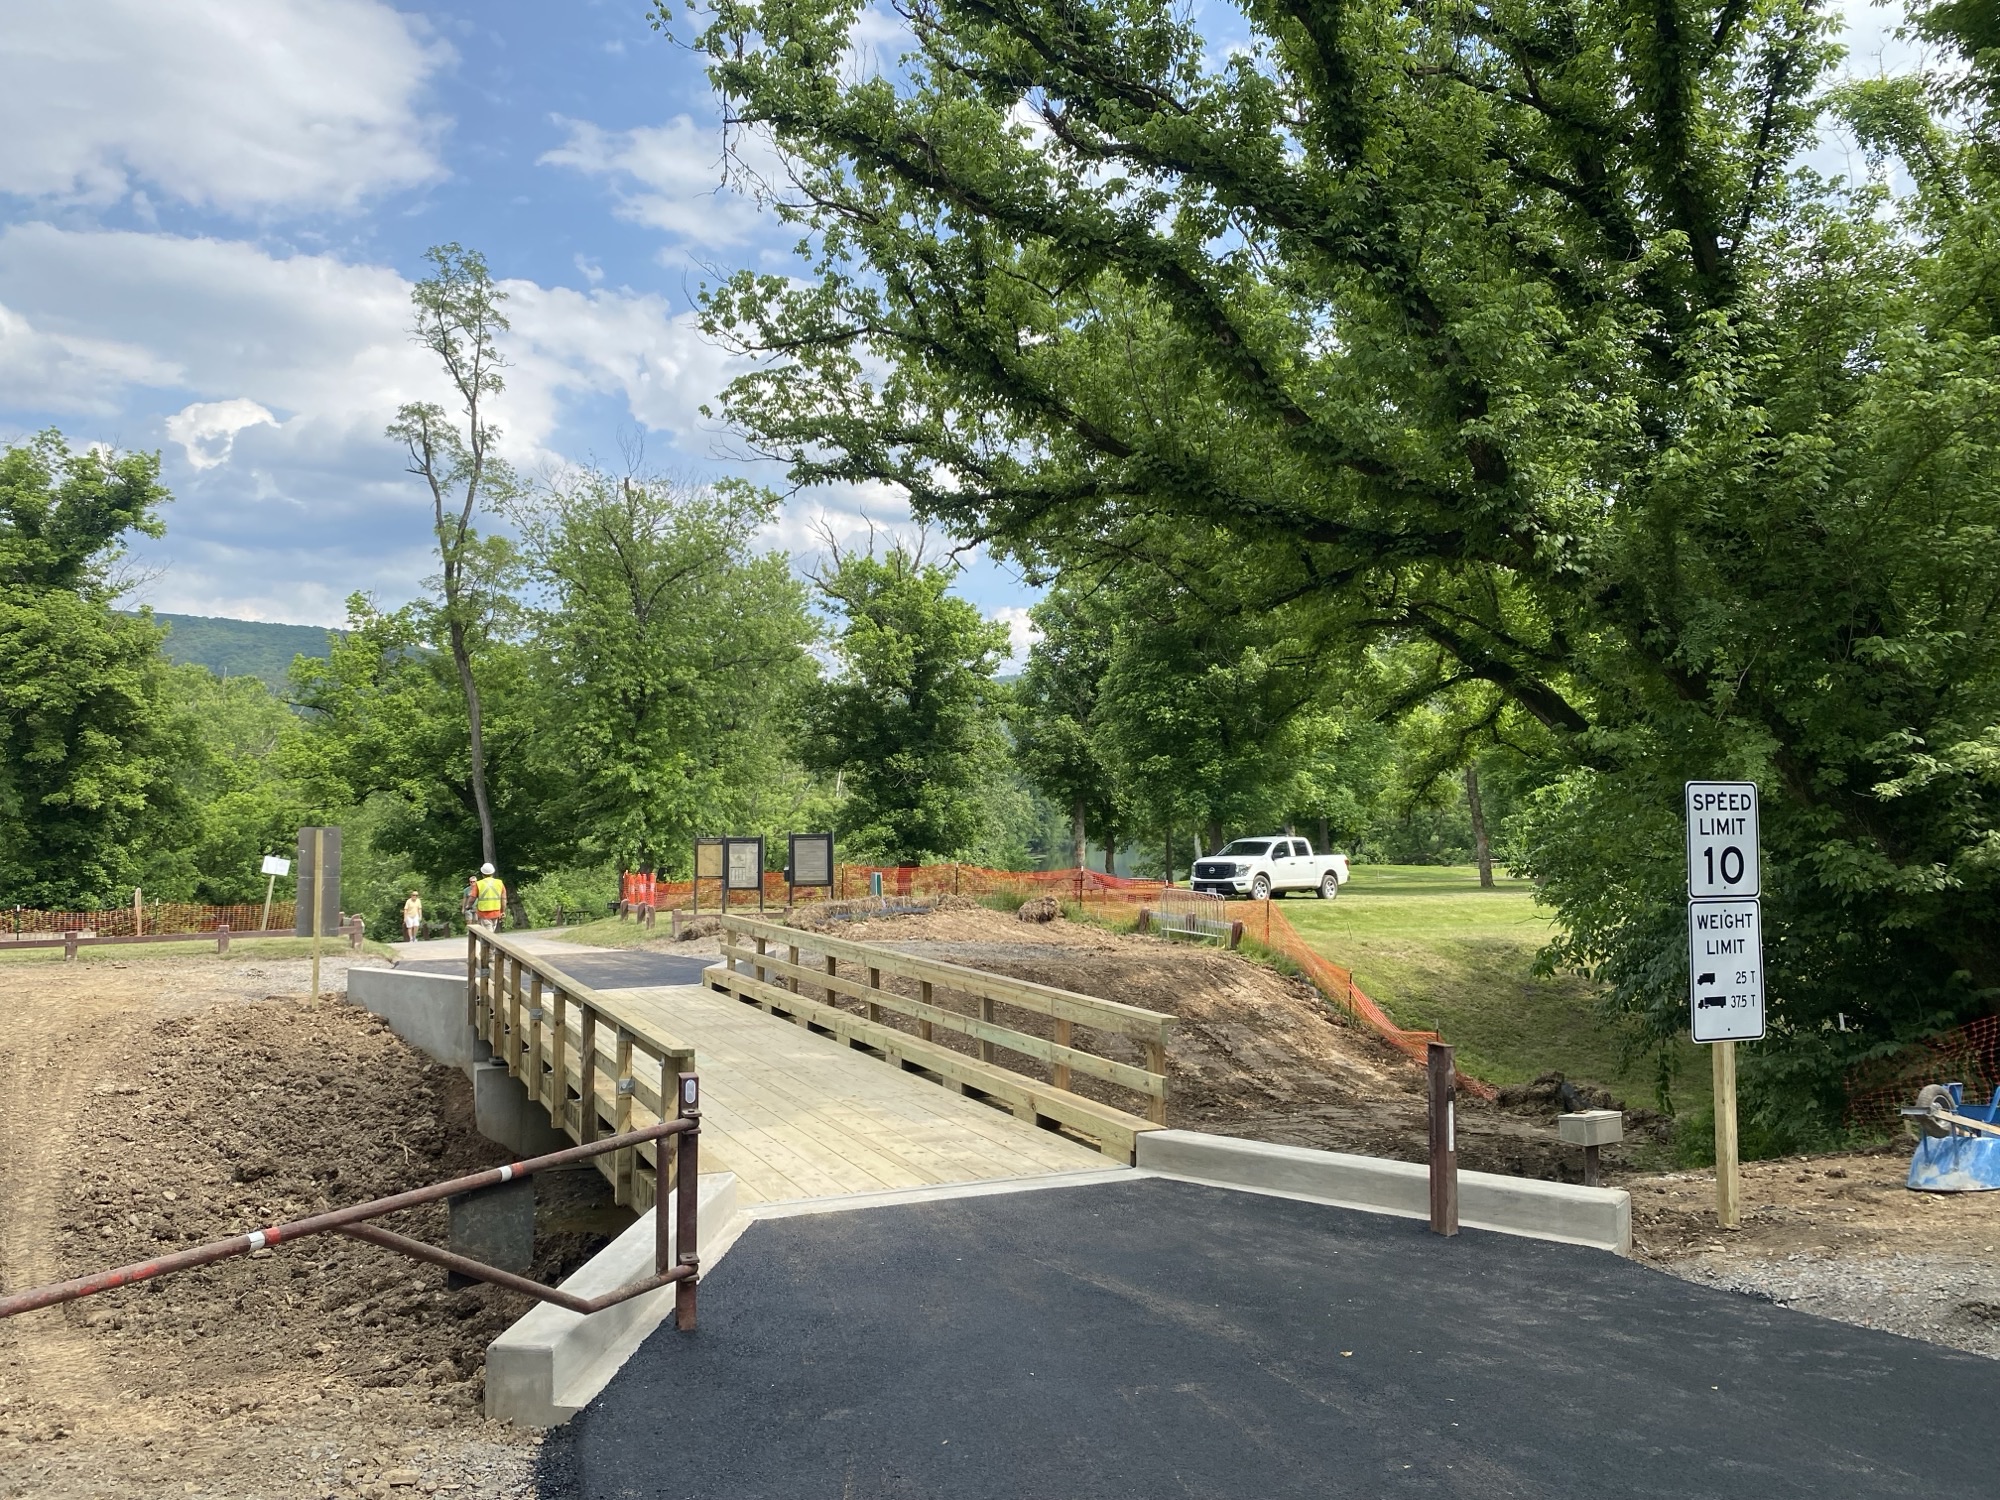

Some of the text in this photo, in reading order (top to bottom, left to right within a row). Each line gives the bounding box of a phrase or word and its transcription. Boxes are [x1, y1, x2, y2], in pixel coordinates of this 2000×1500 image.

[1693, 792, 1751, 812] SPEED
[1699, 818, 1746, 836] LIMIT
[1703, 845, 1745, 885] 10
[1697, 913, 1753, 930] WEIGHT
[1706, 939, 1745, 955] LIMIT
[1735, 970, 1756, 984] 25 T
[1750, 994, 1756, 1007] T
